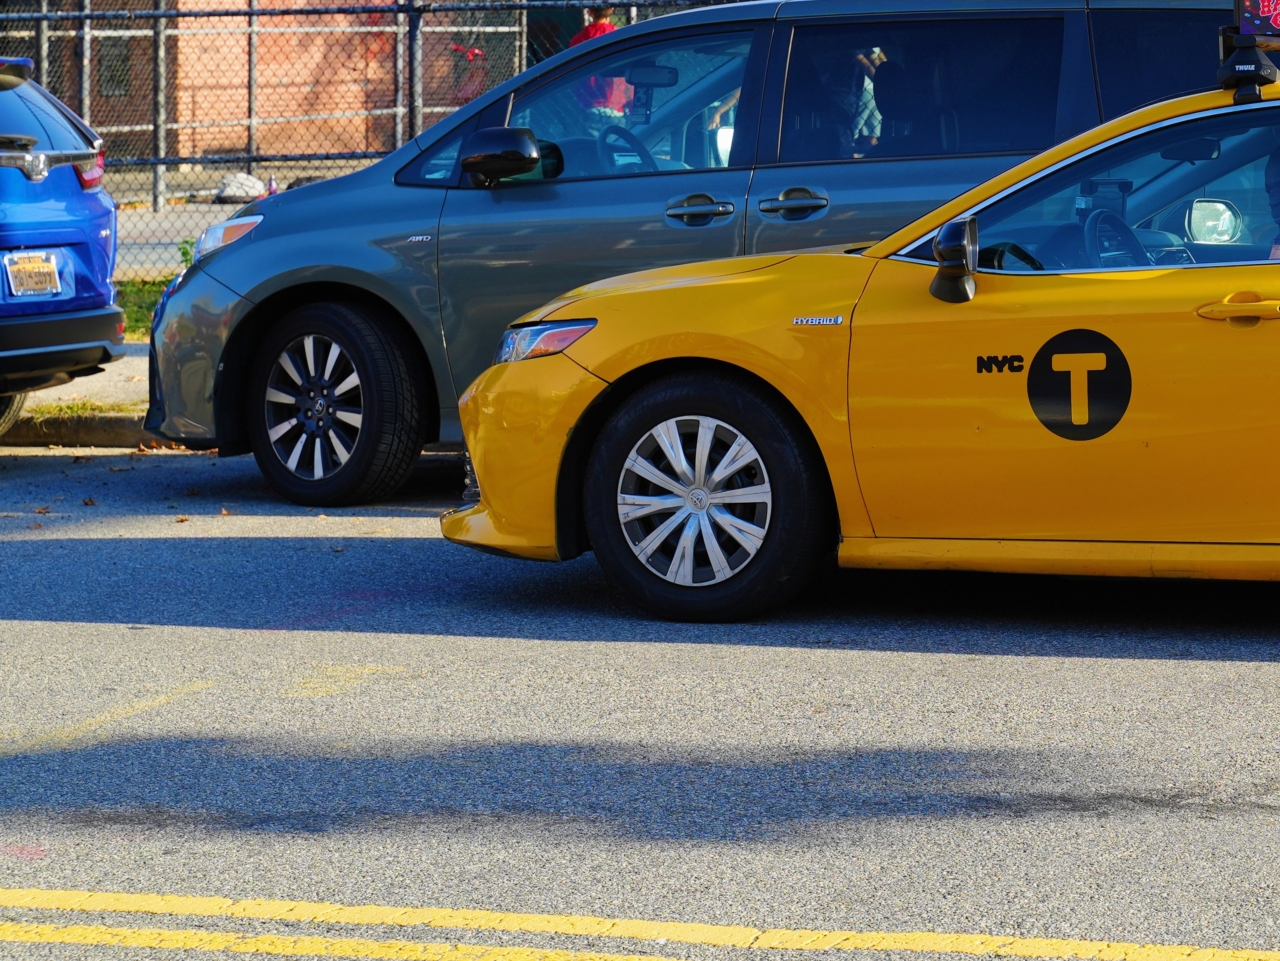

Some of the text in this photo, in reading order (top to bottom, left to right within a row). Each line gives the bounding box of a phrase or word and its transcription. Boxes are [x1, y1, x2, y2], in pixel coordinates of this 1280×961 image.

[793, 317, 835, 325] HYBRID
[976, 352, 1106, 425] NYC T
